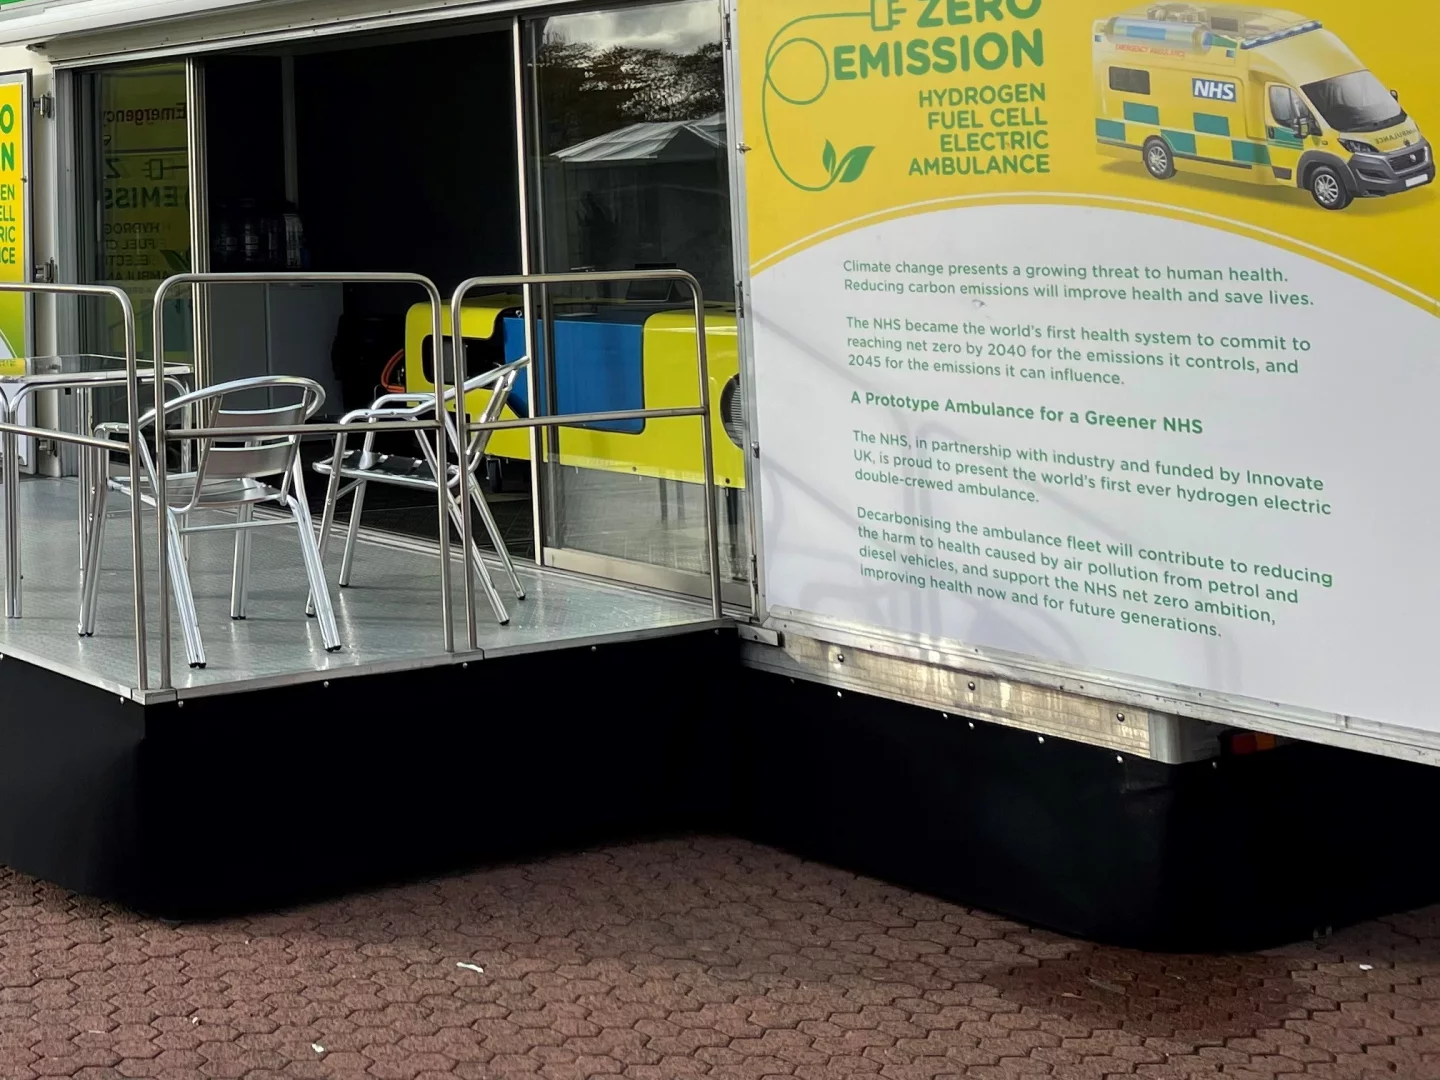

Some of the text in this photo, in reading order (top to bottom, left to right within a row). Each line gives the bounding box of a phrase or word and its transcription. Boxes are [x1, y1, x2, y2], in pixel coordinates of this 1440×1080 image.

[833, 28, 1044, 80] EMISSION
[919, 83, 1045, 108] HYDROGEN
[1194, 80, 1234, 100] NHS
[928, 107, 1048, 129] FUEL CELL
[940, 130, 1049, 152] ELECTRIC
[908, 154, 1050, 176] AMBULANCE
[843, 260, 1288, 282] Climate change presents a growing threat to human health.
[844, 279, 1313, 306] Reducing carbon emissions will improve health and save lives.
[847, 317, 1310, 351] The NHS became the world's first health system to commit to
[847, 336, 1298, 373] reaching net zero by 2040 for the emissions it controls, and
[849, 355, 1124, 384] 2045 for the emissions it can influence.
[851, 391, 1203, 434] A Prototype Ambulance for a Greener NHS
[853, 430, 1323, 490] The NHS, in partnership with industry and funded by Innovate
[854, 450, 1331, 515] UK, is proud to present the world's first ever hydrogen electric
[857, 506, 1333, 587] Decarbonising the ambulance fleet will contribute to reducing
[858, 526, 1298, 603] the harm to health caused by air pollution from petrol and
[859, 546, 1275, 625] diesel vehicles, and support the NHS net zero ambition,
